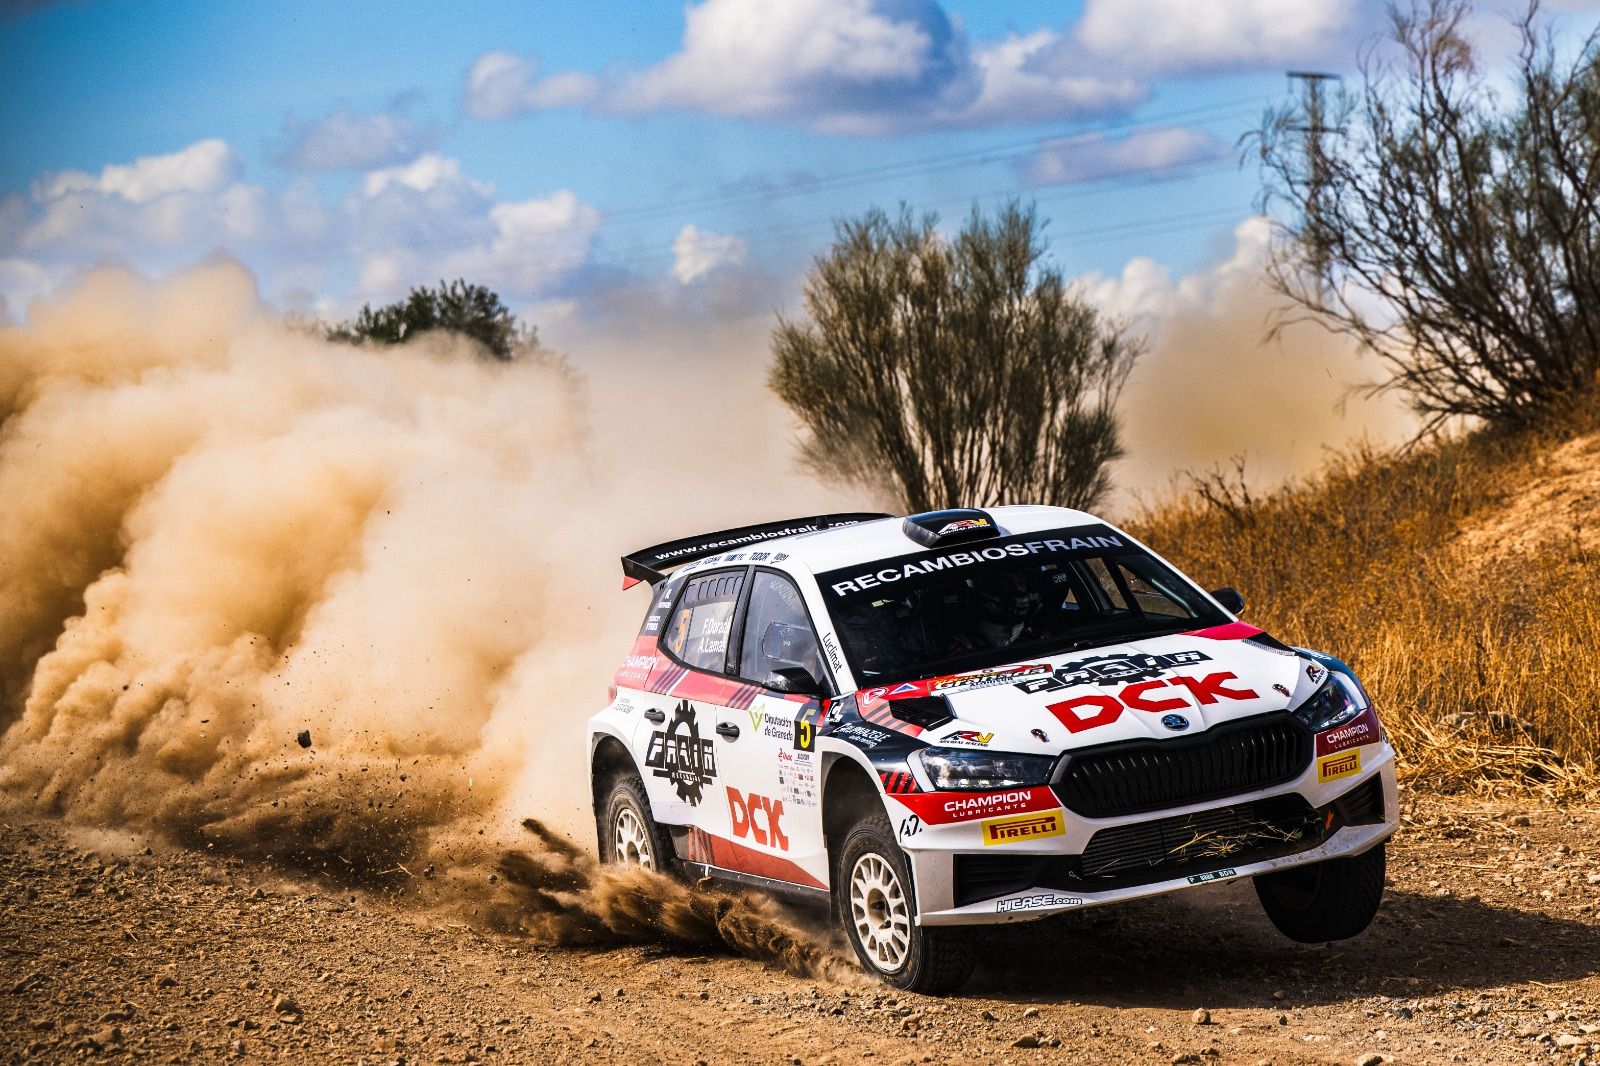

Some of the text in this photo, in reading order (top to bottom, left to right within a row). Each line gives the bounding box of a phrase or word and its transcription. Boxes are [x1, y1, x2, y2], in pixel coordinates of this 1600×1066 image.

[831, 535, 1123, 597] RECAMBIOSFRAIN
[822, 632, 843, 674] Luclimat
[1045, 672, 1260, 734] DCK
[800, 708, 816, 749] 5
[1326, 723, 1369, 744] CHAMPION
[1322, 754, 1358, 777] PIRELLI
[944, 791, 1032, 812] CHAMPION
[952, 803, 1027, 818] LUBRICANTS
[725, 785, 790, 852] DCK
[989, 816, 1057, 840] PIRELLI
[996, 893, 1083, 914] HICASE.com
